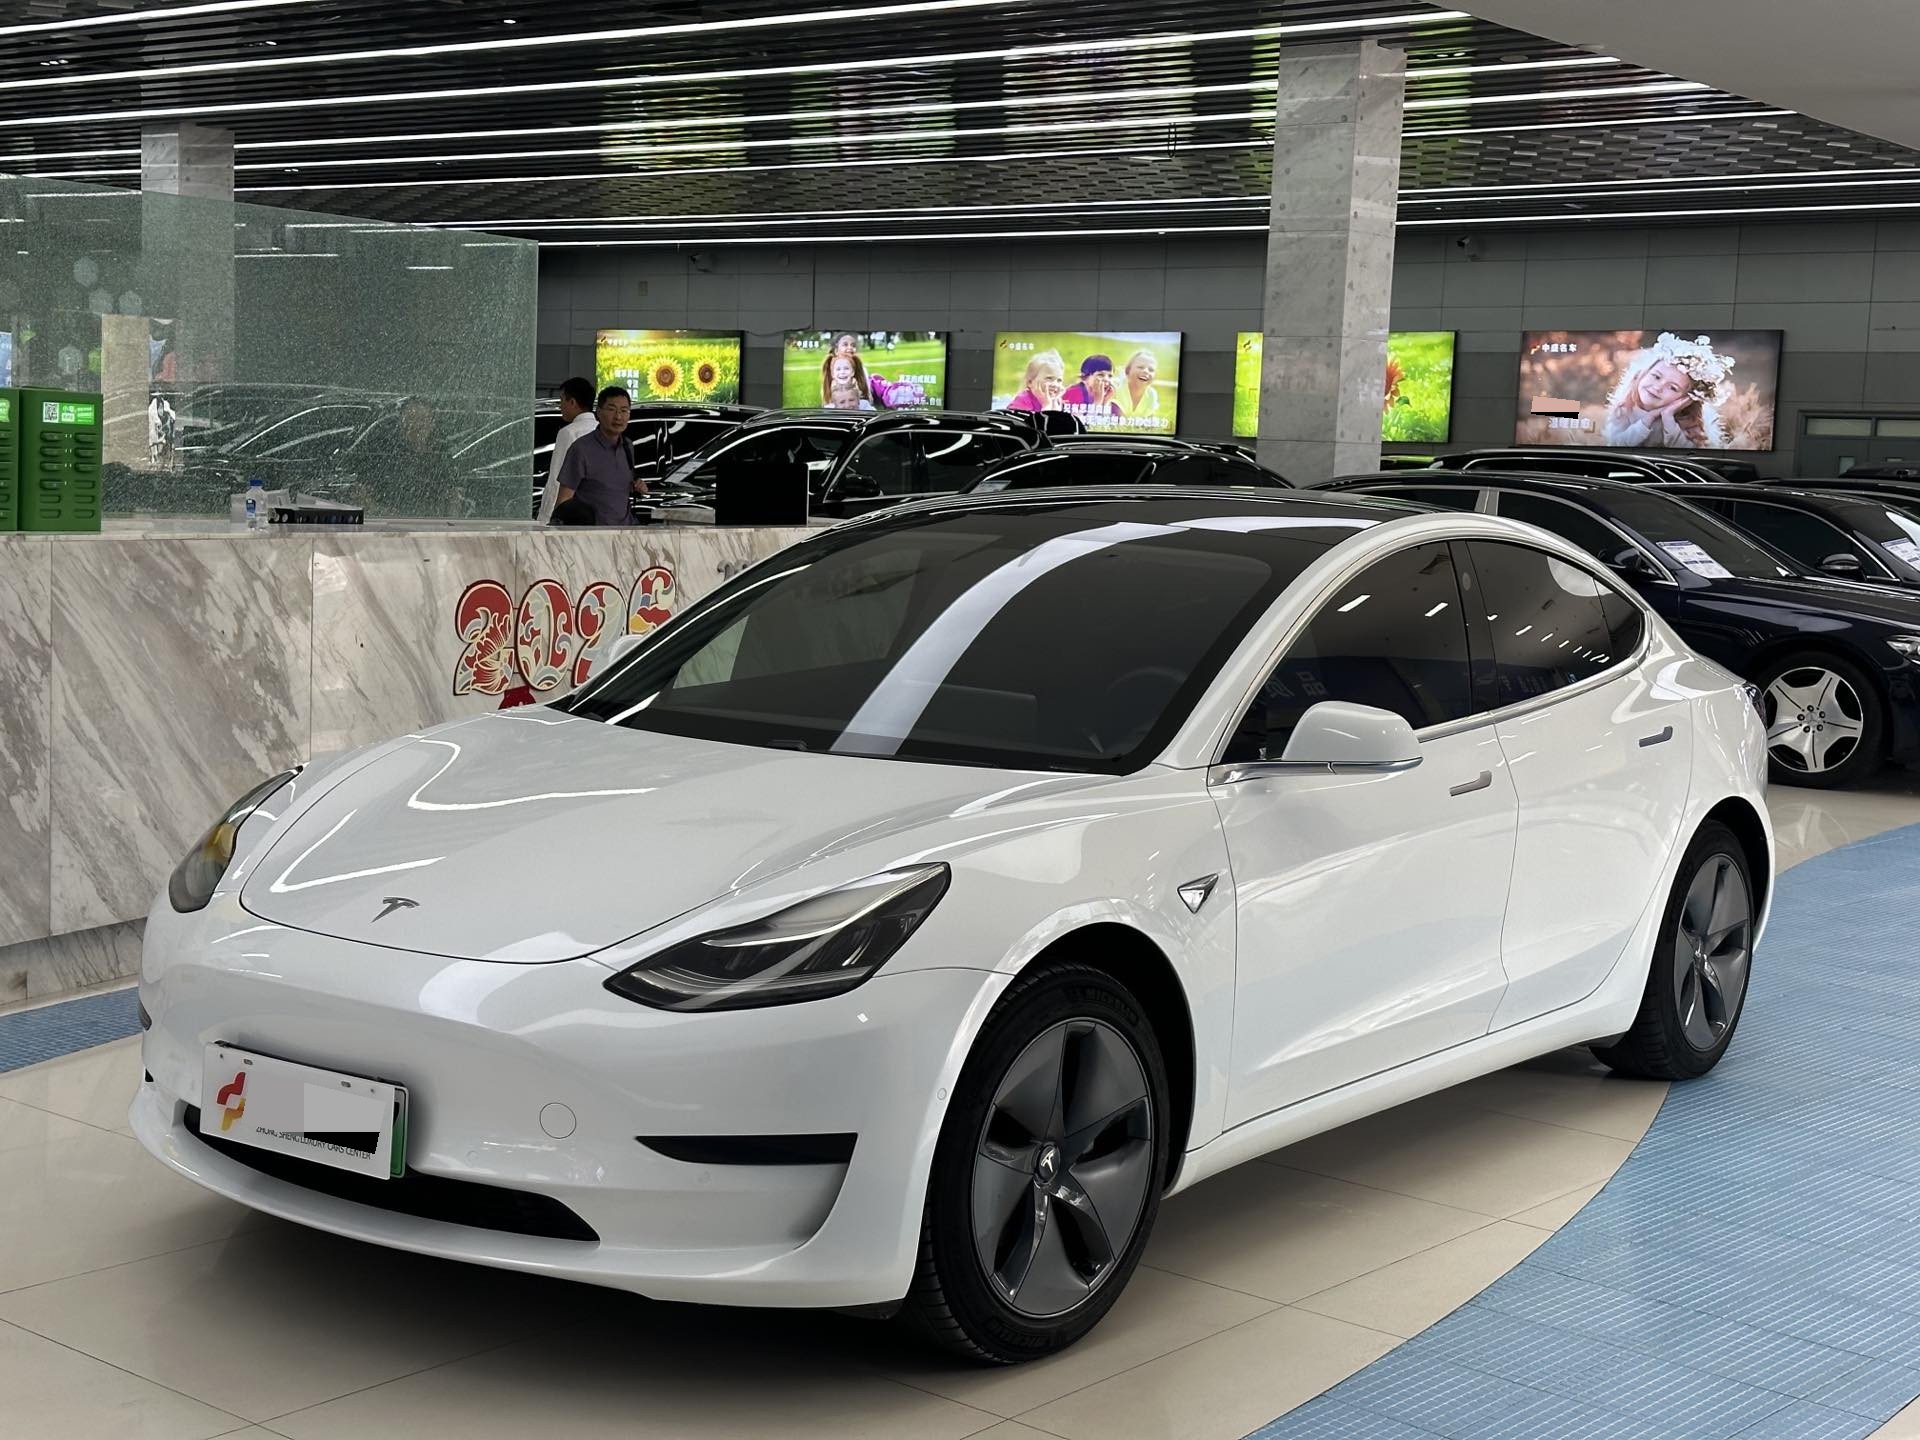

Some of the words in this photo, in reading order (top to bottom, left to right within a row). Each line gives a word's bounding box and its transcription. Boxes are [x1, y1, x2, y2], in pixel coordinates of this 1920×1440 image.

[1541, 343, 1577, 353] 中盛名车
[345, 1146, 371, 1160] CENTER
